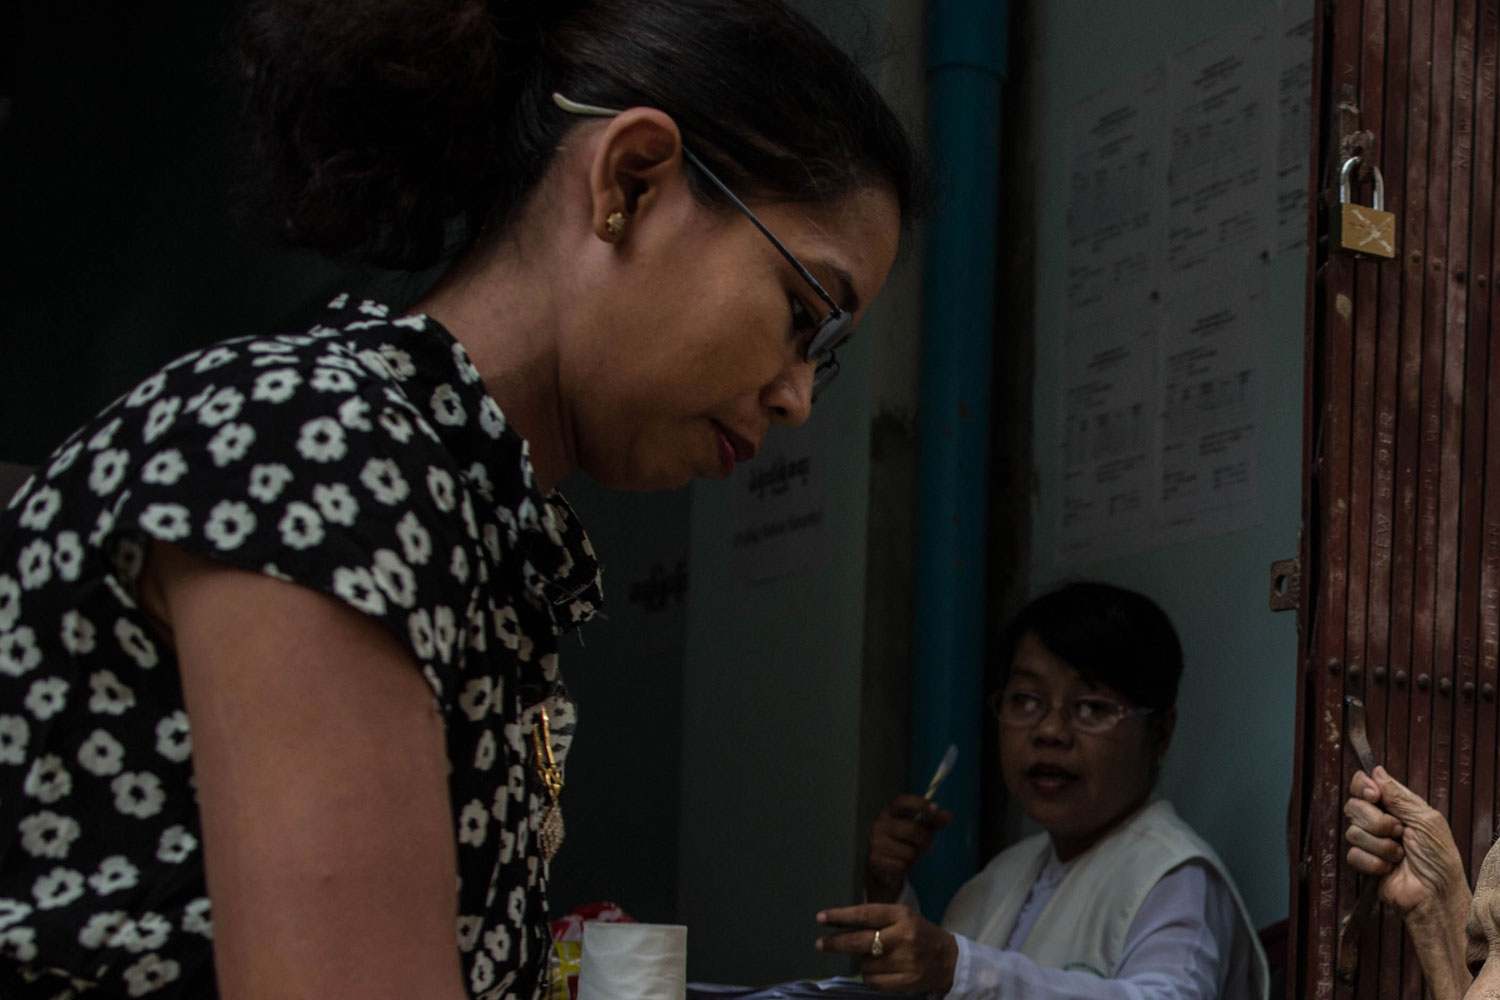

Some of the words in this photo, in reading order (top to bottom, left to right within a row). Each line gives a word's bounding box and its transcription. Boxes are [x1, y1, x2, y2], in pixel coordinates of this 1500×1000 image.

[1376, 513, 1391, 568] NEW
[1458, 730, 1471, 786] NEW
[1319, 849, 1336, 910] NEW
